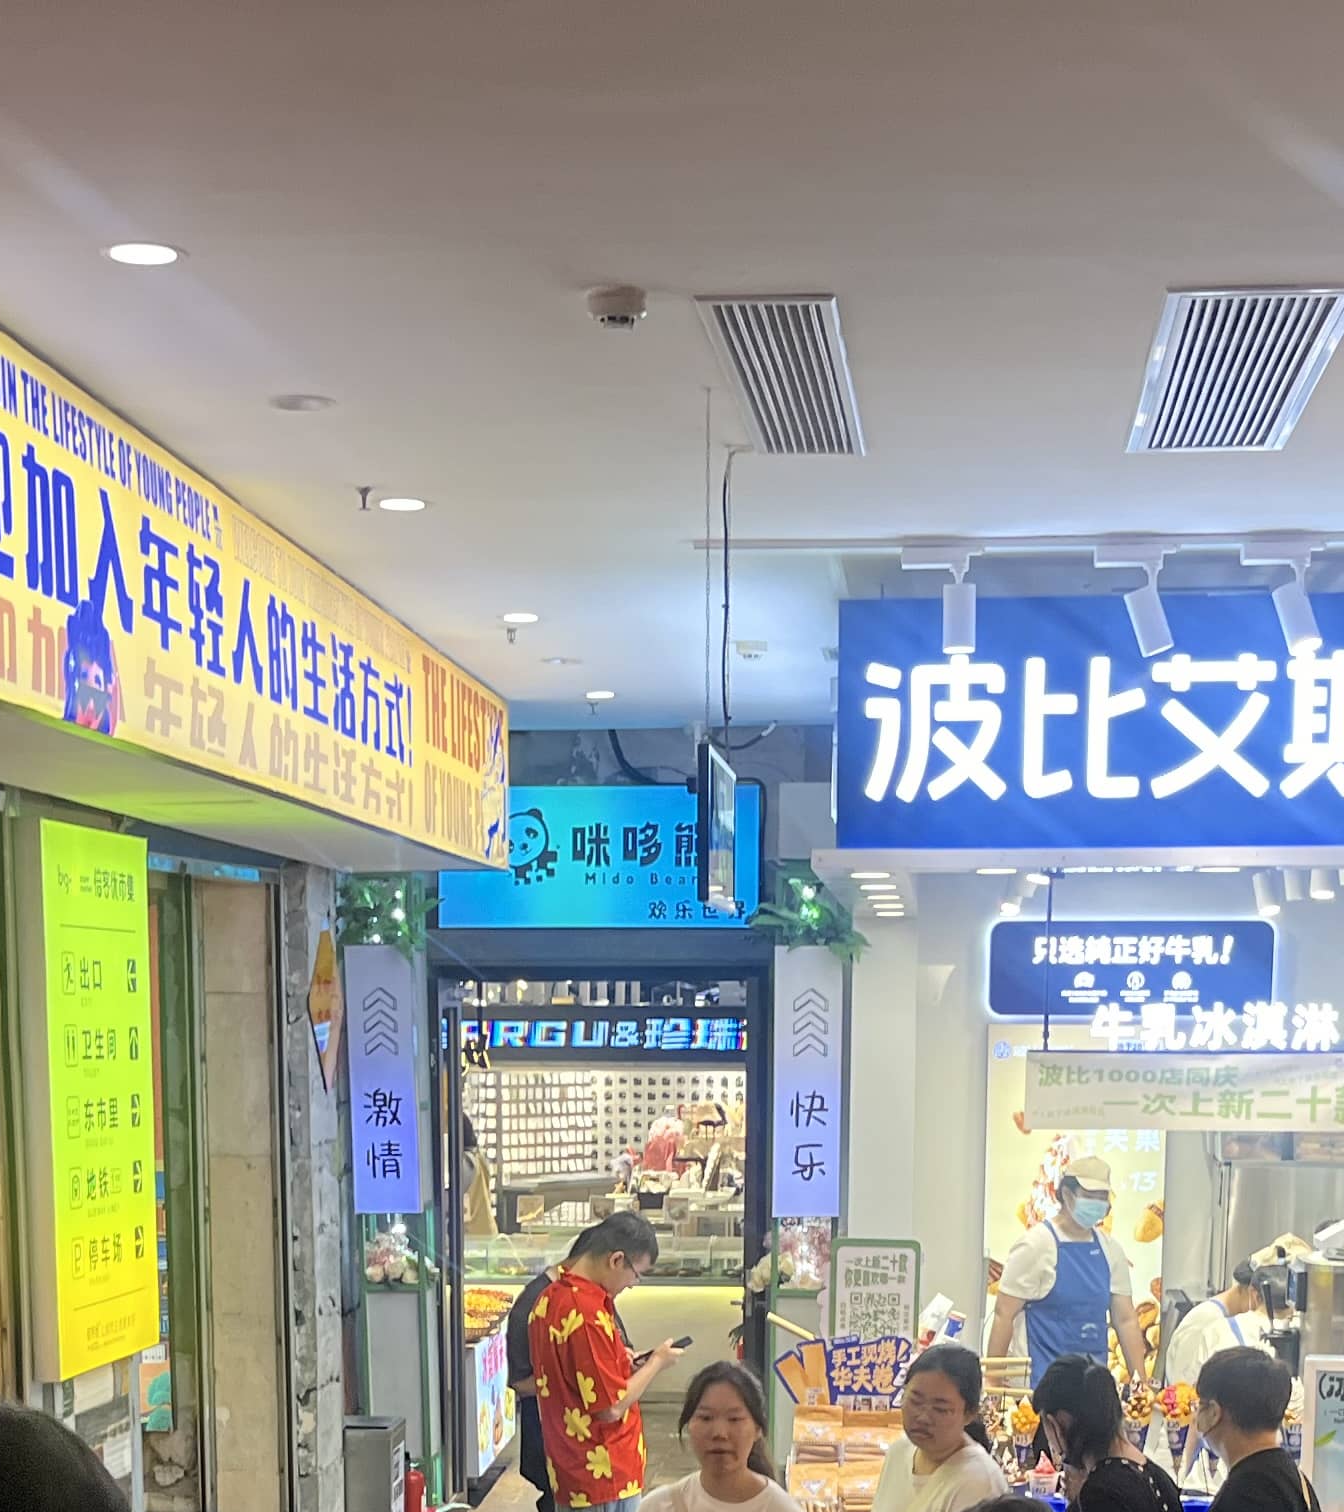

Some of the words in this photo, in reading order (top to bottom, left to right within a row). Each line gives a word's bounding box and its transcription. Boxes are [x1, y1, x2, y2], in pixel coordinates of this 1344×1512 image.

[20, 369, 49, 438] THE
[51, 391, 116, 481] LIFESTYLE
[118, 437, 132, 491] OF
[134, 448, 173, 517] YOUNG
[422, 653, 448, 754] THE
[584, 871, 634, 886] Mido
[80, 956, 103, 990] 出口
[1090, 1000, 1340, 1052] 牛乳冰淇淋
[82, 1029, 117, 1061] 卫生间
[1038, 1062, 1239, 1088] 波比1000店同庆
[84, 1097, 119, 1132] 东市里
[363, 1087, 403, 1180] 激情
[790, 1089, 829, 1181] 快乐
[86, 1166, 109, 1201] 地铁
[88, 1232, 123, 1272] 停车场
